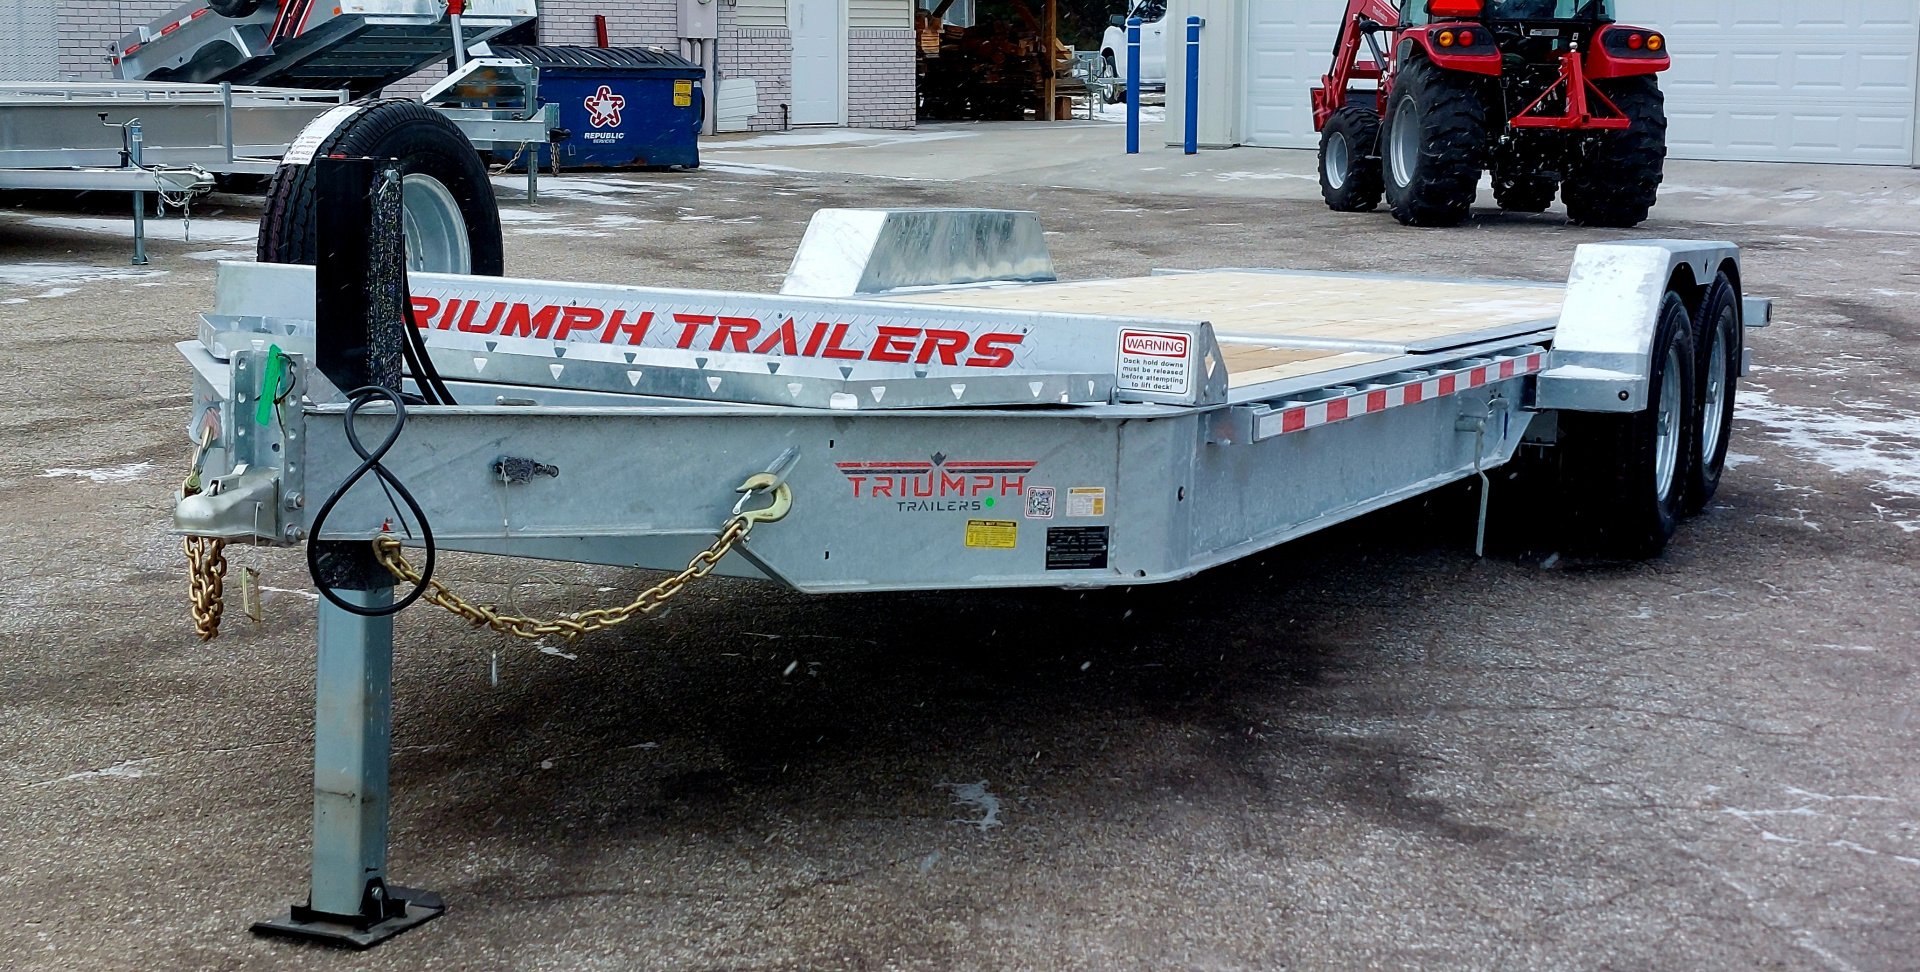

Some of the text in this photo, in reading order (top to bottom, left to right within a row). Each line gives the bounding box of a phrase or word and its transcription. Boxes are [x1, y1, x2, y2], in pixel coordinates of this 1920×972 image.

[401, 296, 1025, 368] RIUMPH TRAILERS
[1127, 338, 1183, 353] WARNING
[1123, 357, 1184, 368] Deck hold downs
[1122, 365, 1140, 373] must
[1153, 367, 1184, 376] released
[1145, 375, 1184, 385] attempting
[1153, 383, 1173, 391] deck!
[847, 471, 1026, 498] TRIUMPH
[897, 500, 981, 512] TRAILERS
